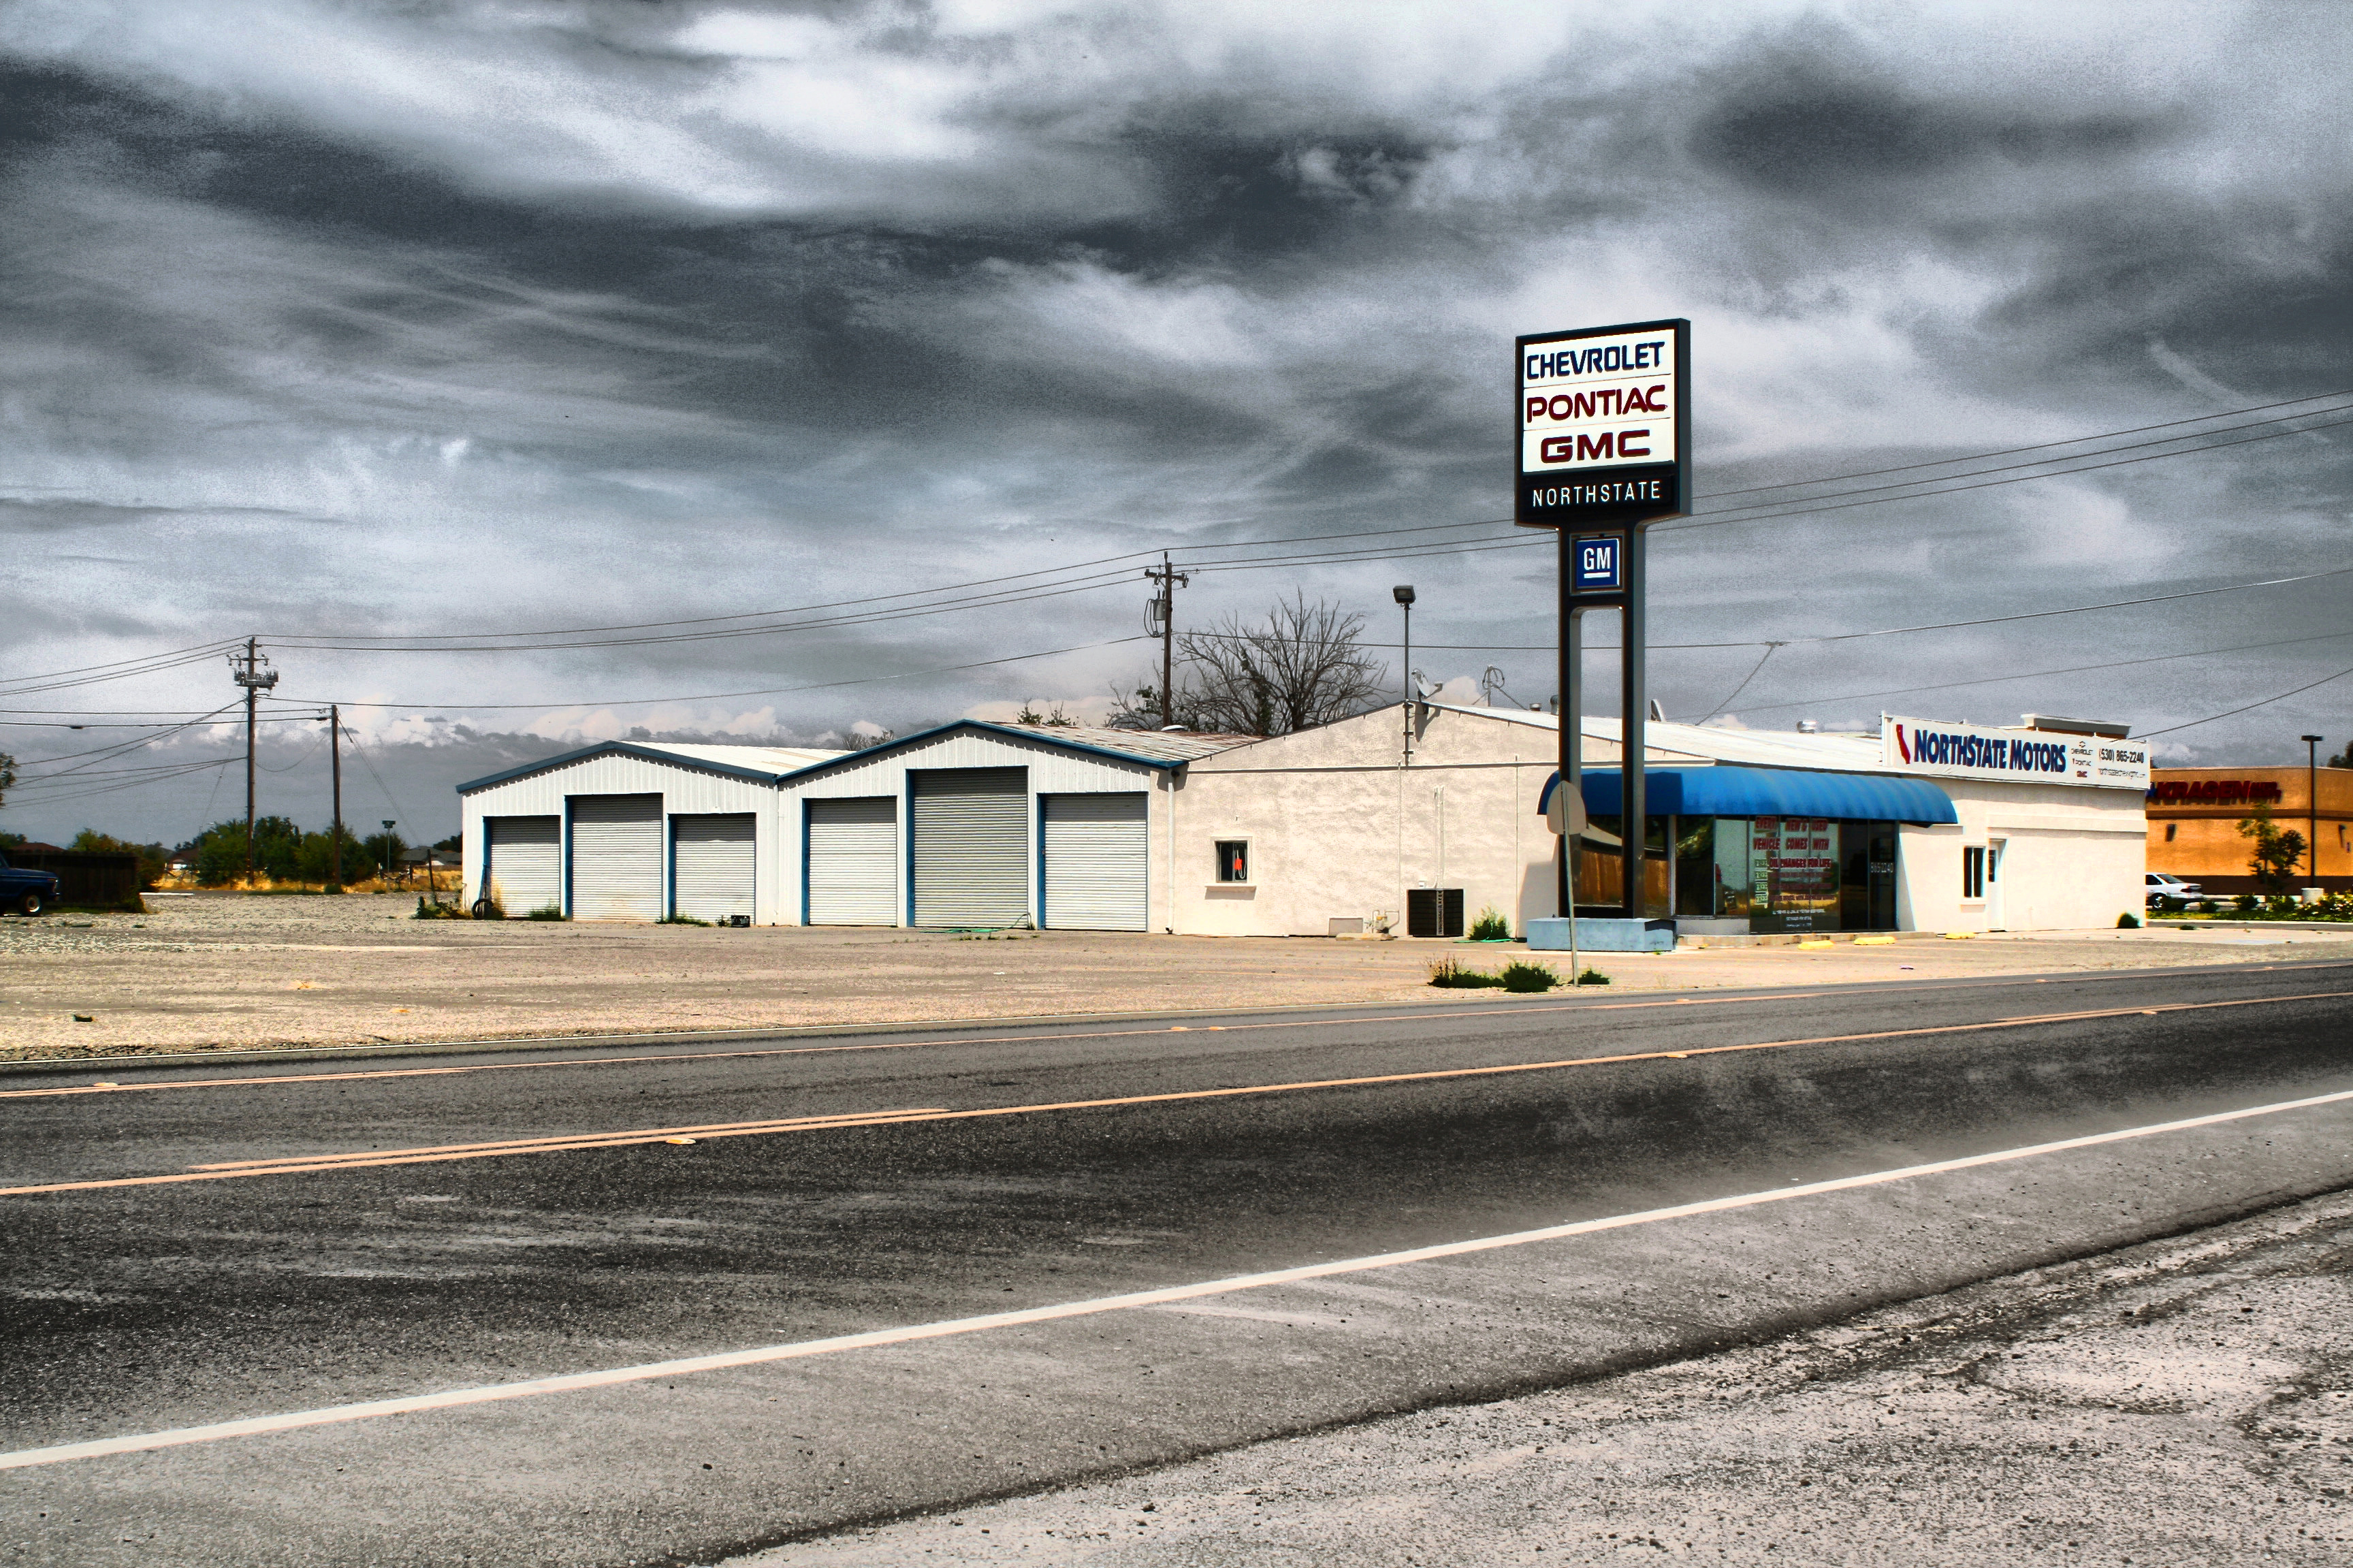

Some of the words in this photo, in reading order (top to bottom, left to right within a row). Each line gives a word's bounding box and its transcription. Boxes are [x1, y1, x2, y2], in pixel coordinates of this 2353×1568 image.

[1526, 342, 1665, 380] CHEVROLET
[1526, 385, 1668, 423] PONTIAC
[1541, 430, 1650, 463] GMC
[1533, 481, 1661, 507] NORTHSTATE
[1584, 547, 1611, 571] GM
[1914, 729, 2006, 769] NORTHSTATE
[2009, 739, 2066, 773] MOTORS
